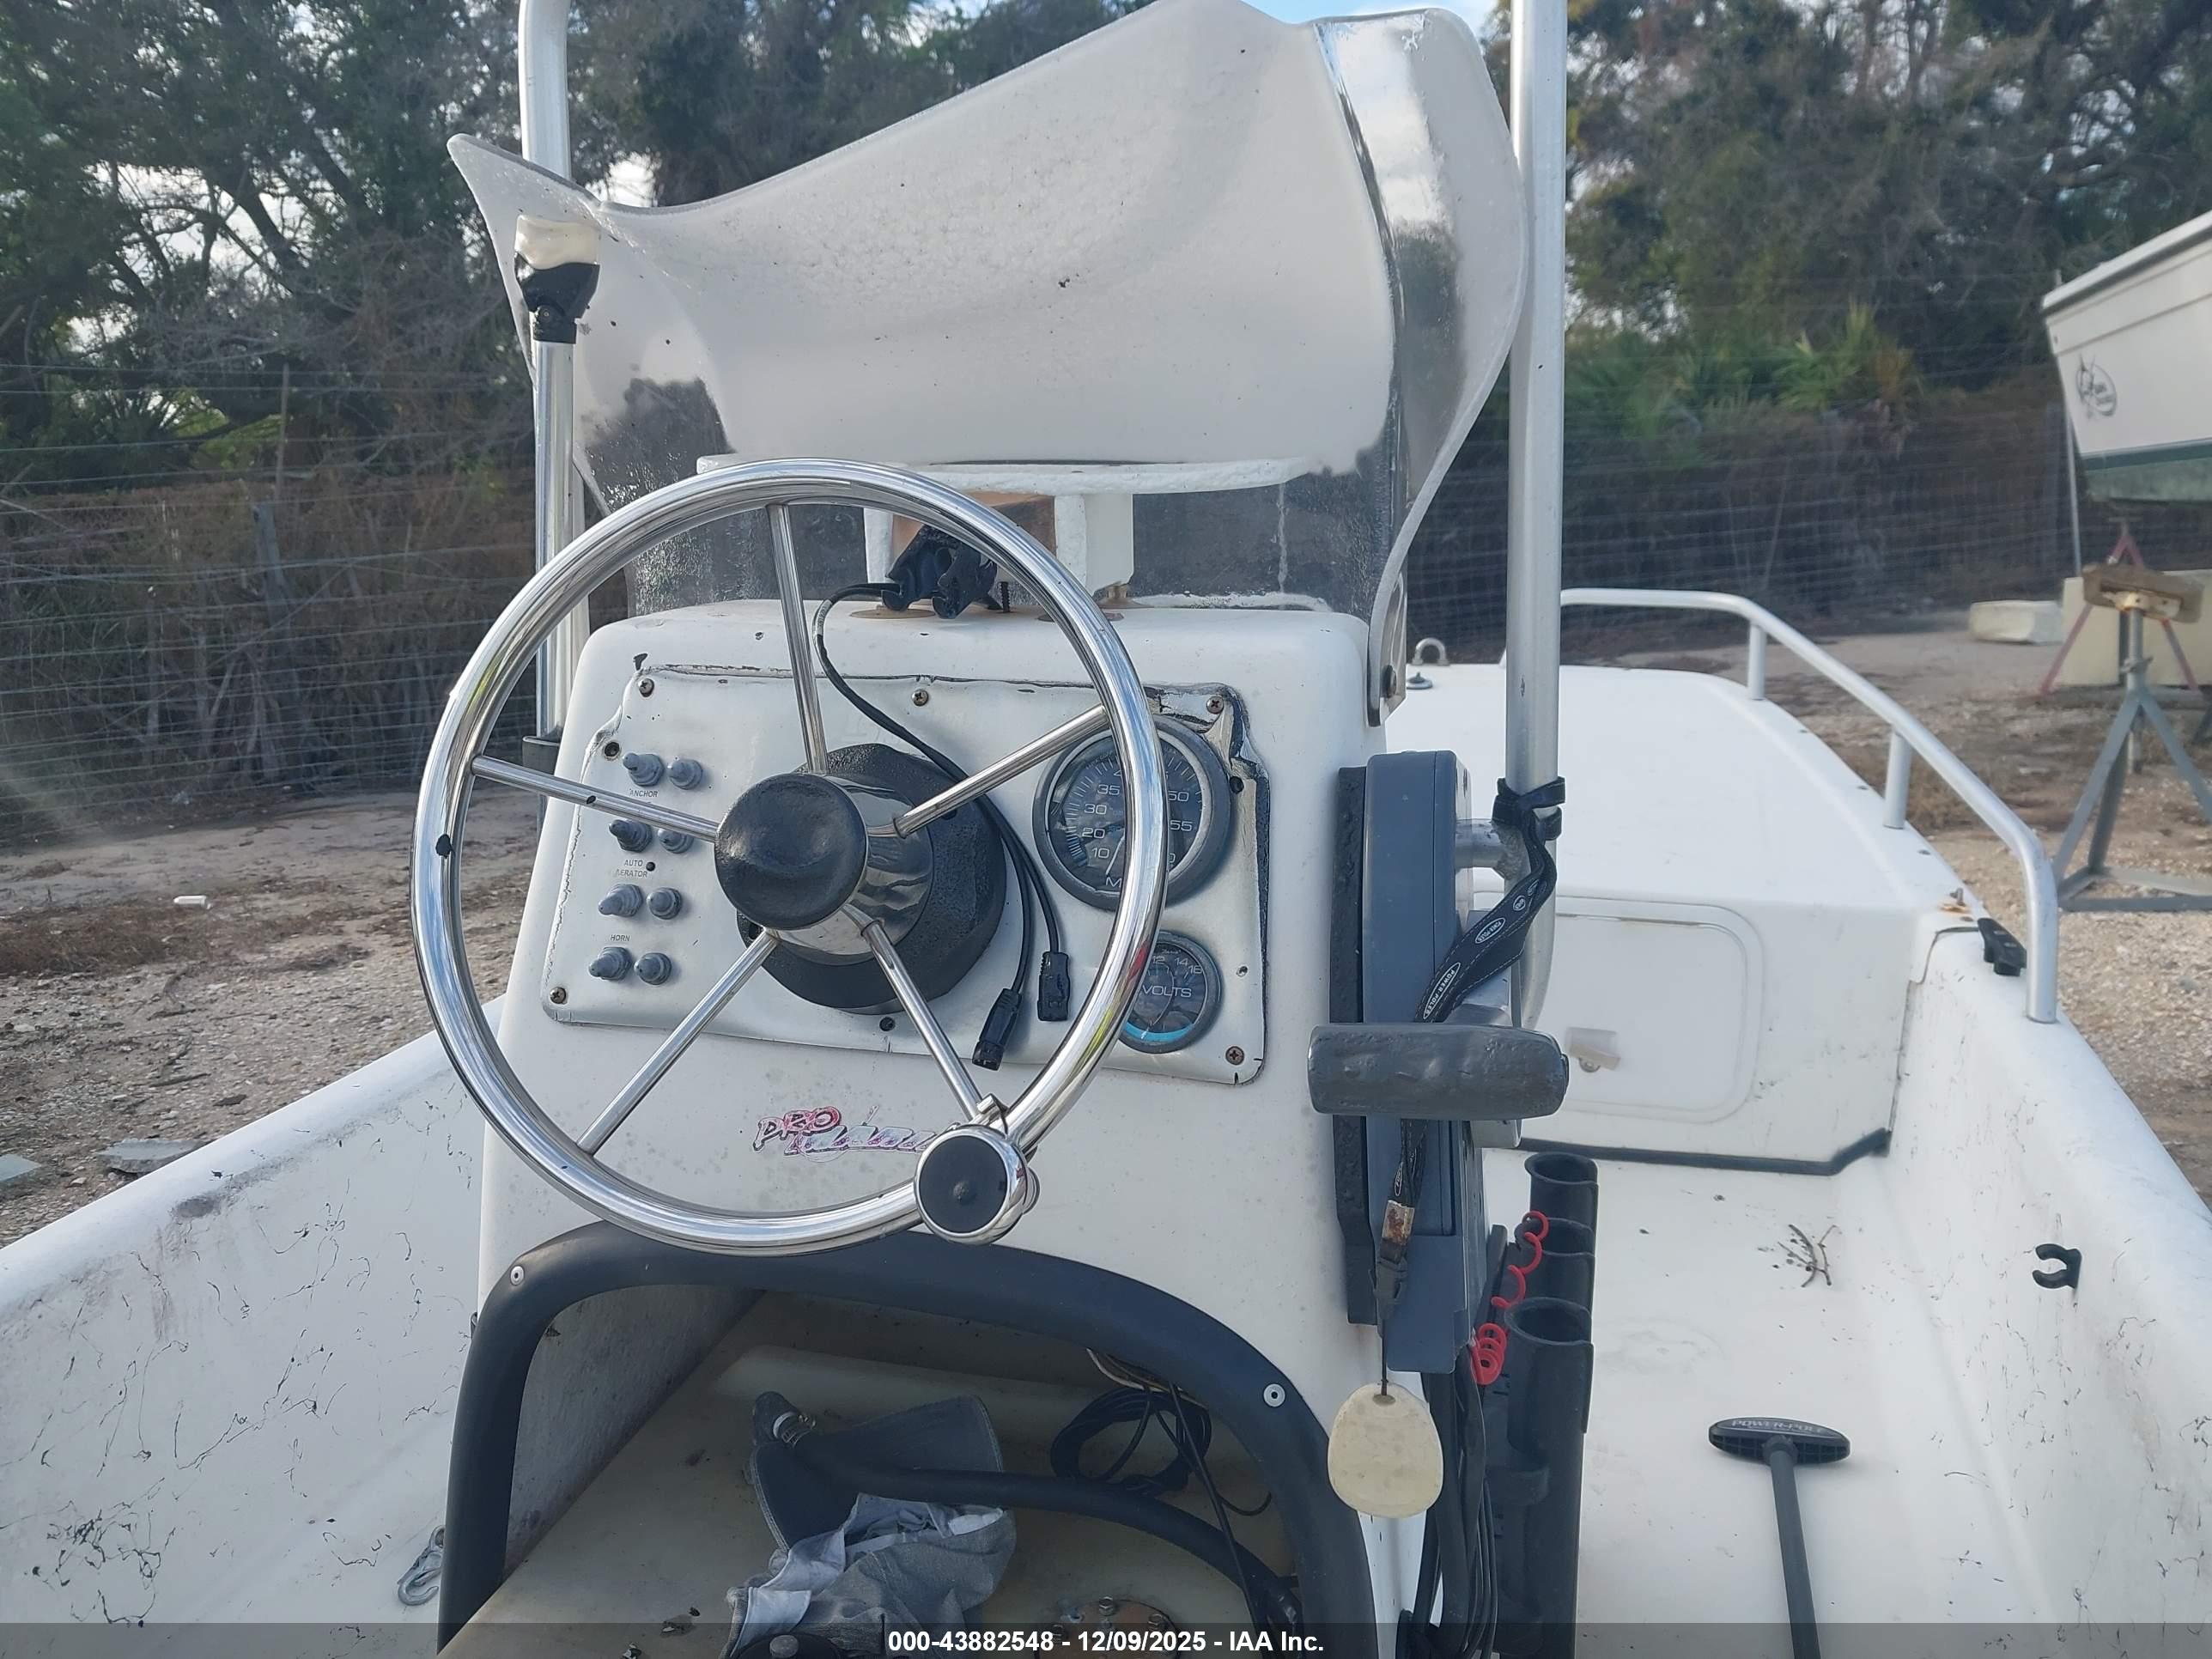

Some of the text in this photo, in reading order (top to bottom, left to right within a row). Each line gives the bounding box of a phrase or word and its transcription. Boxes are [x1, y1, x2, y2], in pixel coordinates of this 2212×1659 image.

[1097, 785, 1120, 795] 35
[1168, 791, 1188, 802] 50
[1085, 804, 1107, 814] 30
[1170, 820, 1192, 831] 55
[1082, 827, 1105, 838] 20
[1092, 848, 1109, 859] 10
[1175, 957, 1188, 966] 14
[1143, 985, 1192, 997] VOLTS
